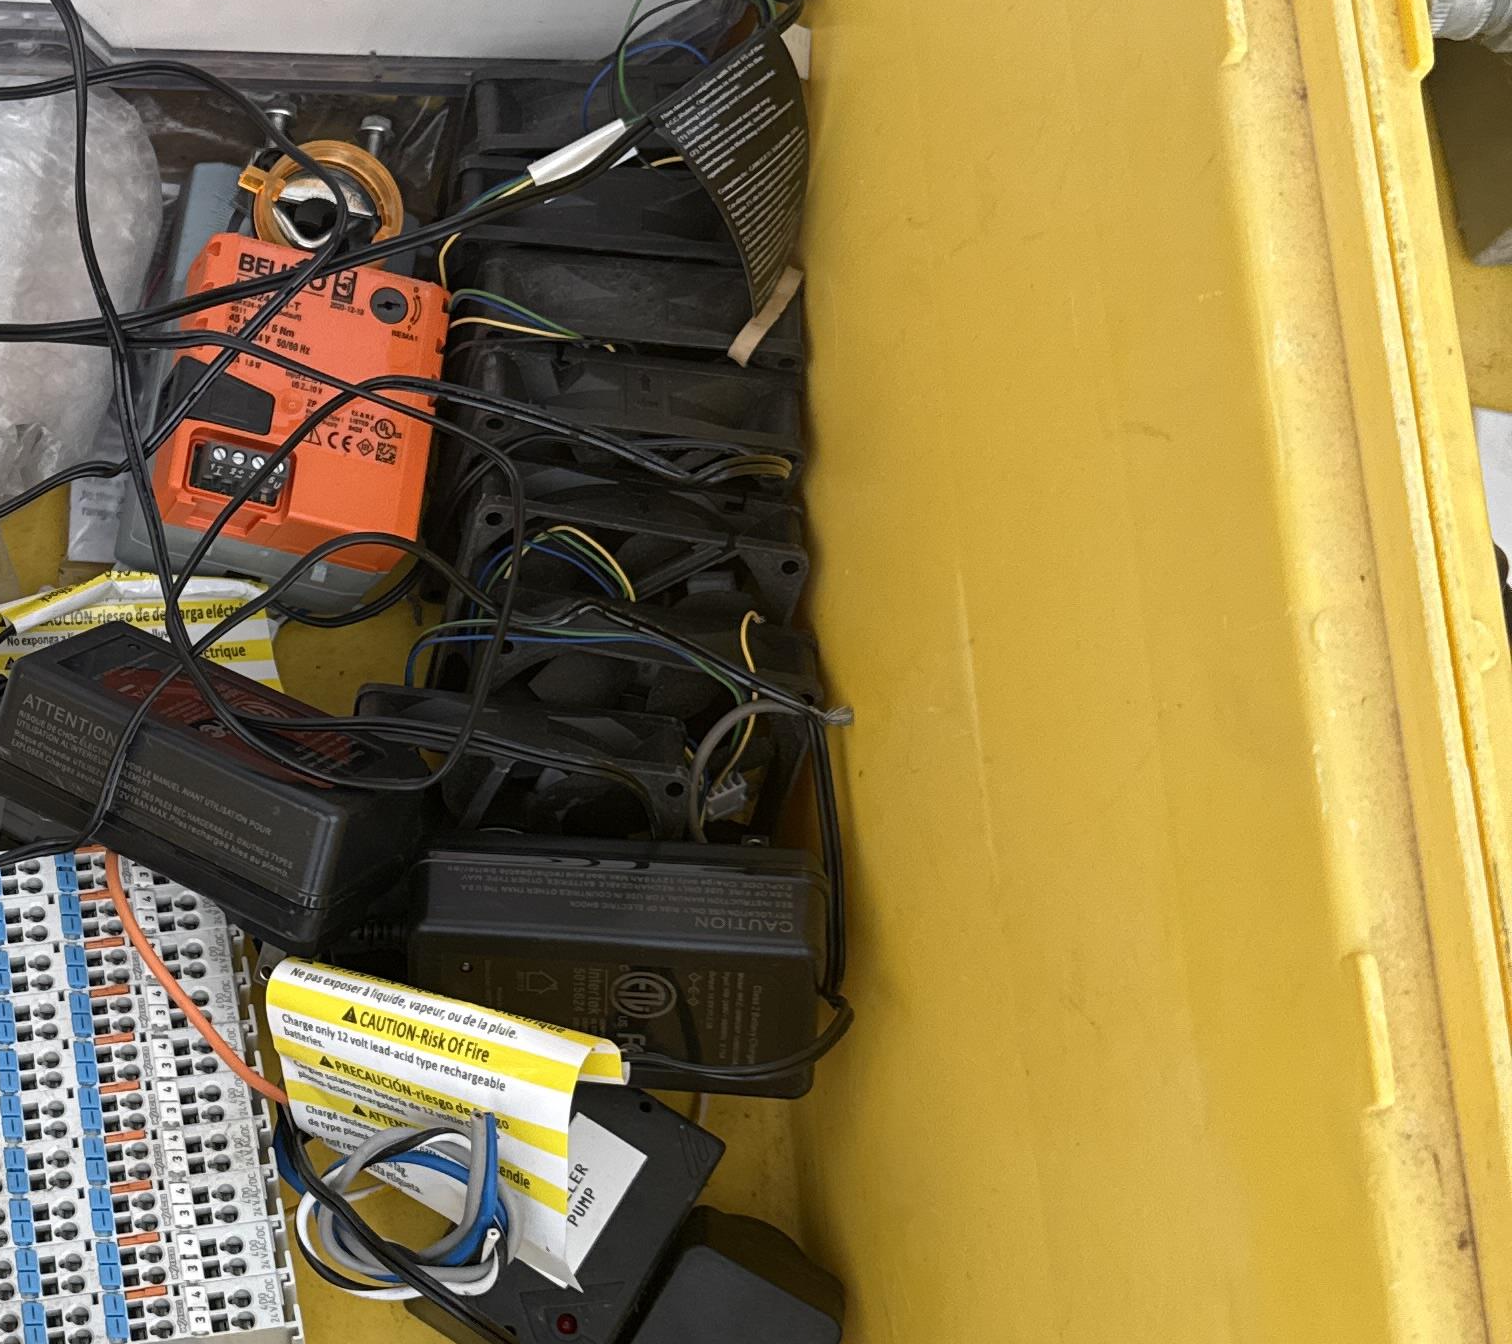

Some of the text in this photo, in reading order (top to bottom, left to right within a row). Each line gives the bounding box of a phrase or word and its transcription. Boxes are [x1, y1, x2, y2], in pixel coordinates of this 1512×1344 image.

[239, 253, 327, 291] BELIO
[136, 608, 150, 622] de
[19, 691, 123, 748] ATTENTION
[693, 914, 793, 933] CAUTION
[290, 965, 306, 979] Ne
[304, 970, 323, 985] pas
[321, 975, 362, 997] exposer
[362, 986, 370, 997] à
[369, 986, 408, 1009] liquide,
[408, 999, 446, 1021] vapeur,
[447, 1010, 463, 1023] ou
[462, 1013, 478, 1027] de
[477, 1017, 488, 1030] la
[279, 1012, 507, 1093] Charge only 12 volt lead-acid type rechargeable
[282, 1027, 327, 1049] batteries.
[357, 1009, 491, 1064] CAUTION-Risk Of Fire
[330, 1060, 456, 1112] PRECAUCIÓN-riesgo
[564, 1186, 599, 1227] PUMP
